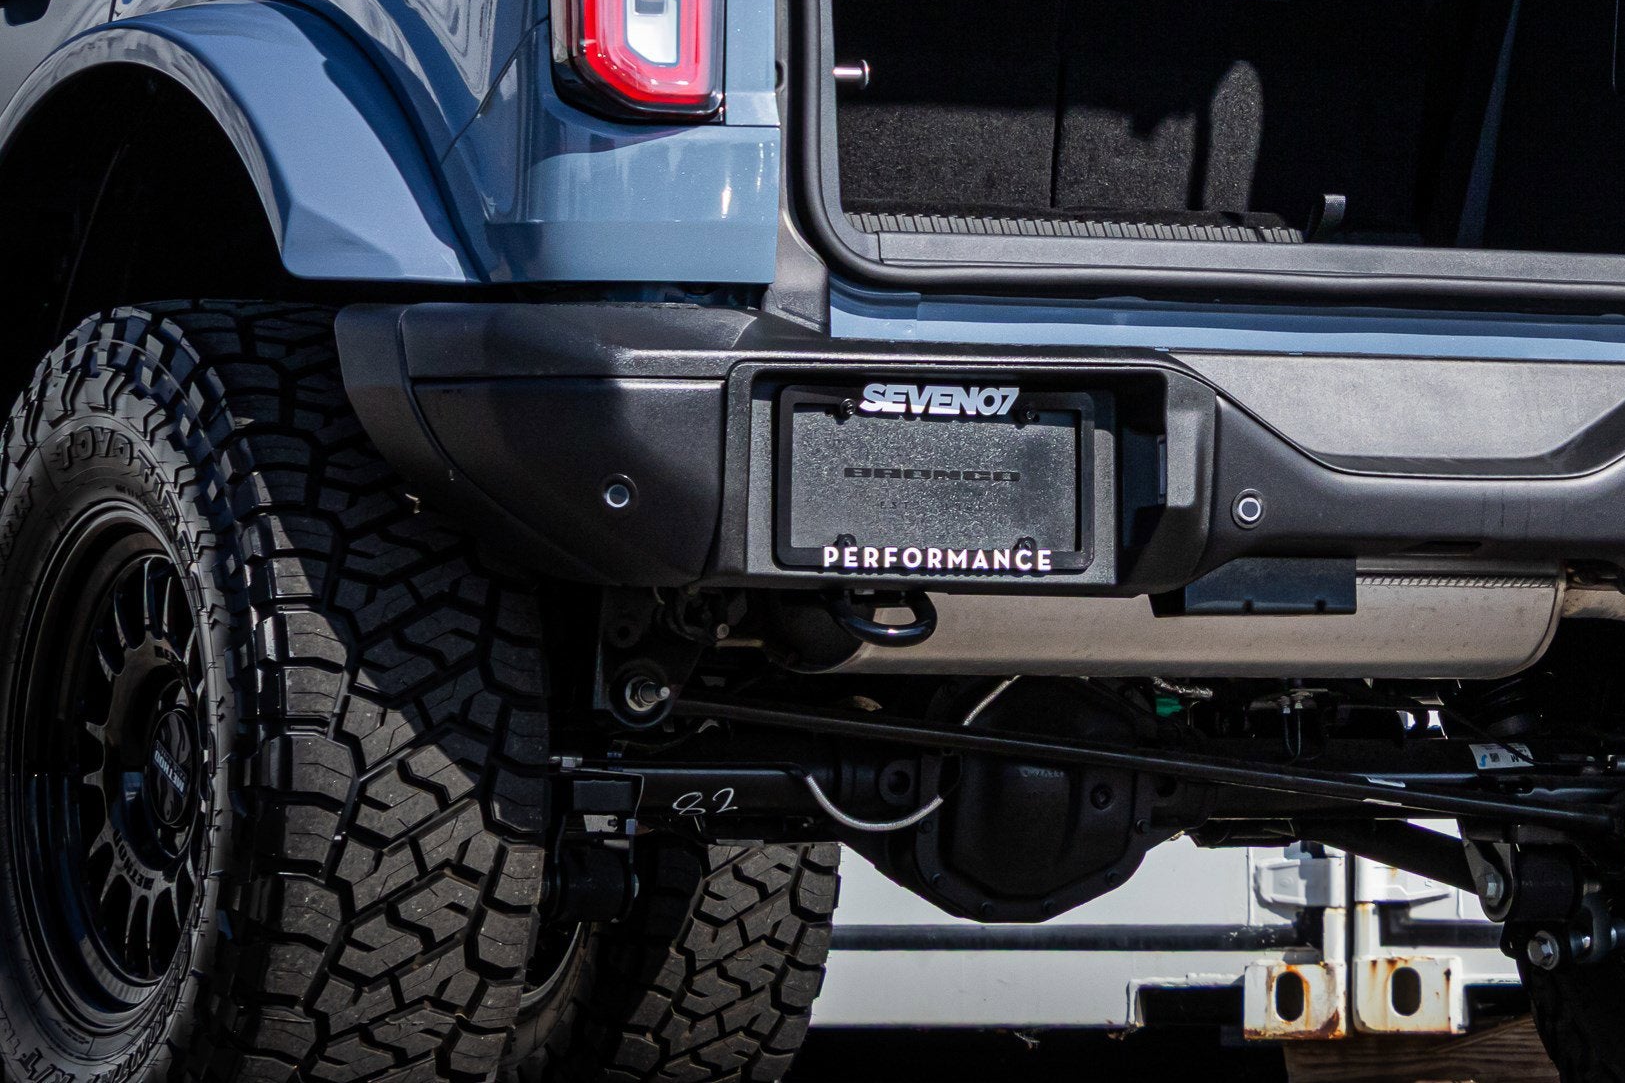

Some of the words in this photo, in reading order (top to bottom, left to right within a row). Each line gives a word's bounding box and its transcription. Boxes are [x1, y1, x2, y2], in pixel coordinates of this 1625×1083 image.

[859, 383, 1020, 416] SEVEN07
[844, 467, 1021, 482] BRONCO
[822, 546, 1052, 572] PERFORMANCE
